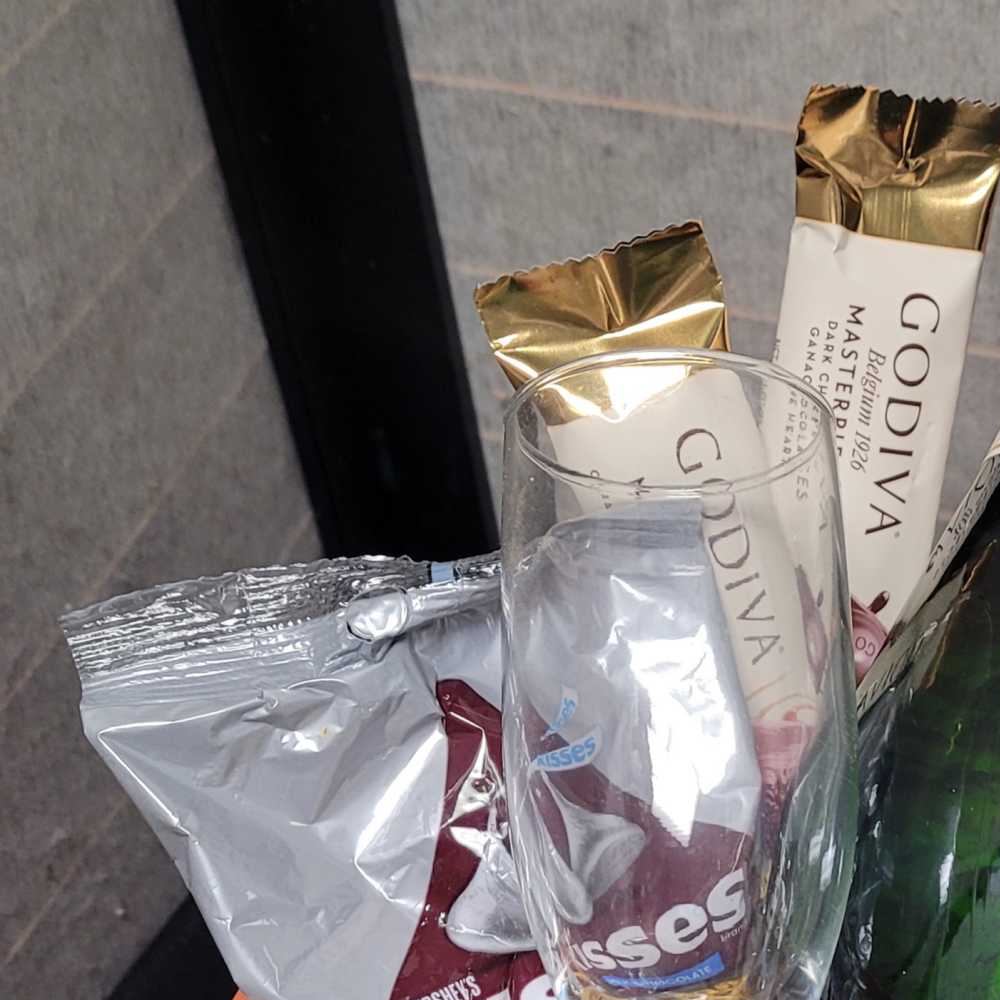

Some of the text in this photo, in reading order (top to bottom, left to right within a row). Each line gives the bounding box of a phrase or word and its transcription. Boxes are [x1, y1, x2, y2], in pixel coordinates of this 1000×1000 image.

[821, 320, 838, 364] DARK
[849, 347, 887, 474] Belgium 1926
[865, 292, 941, 536] GODIVA
